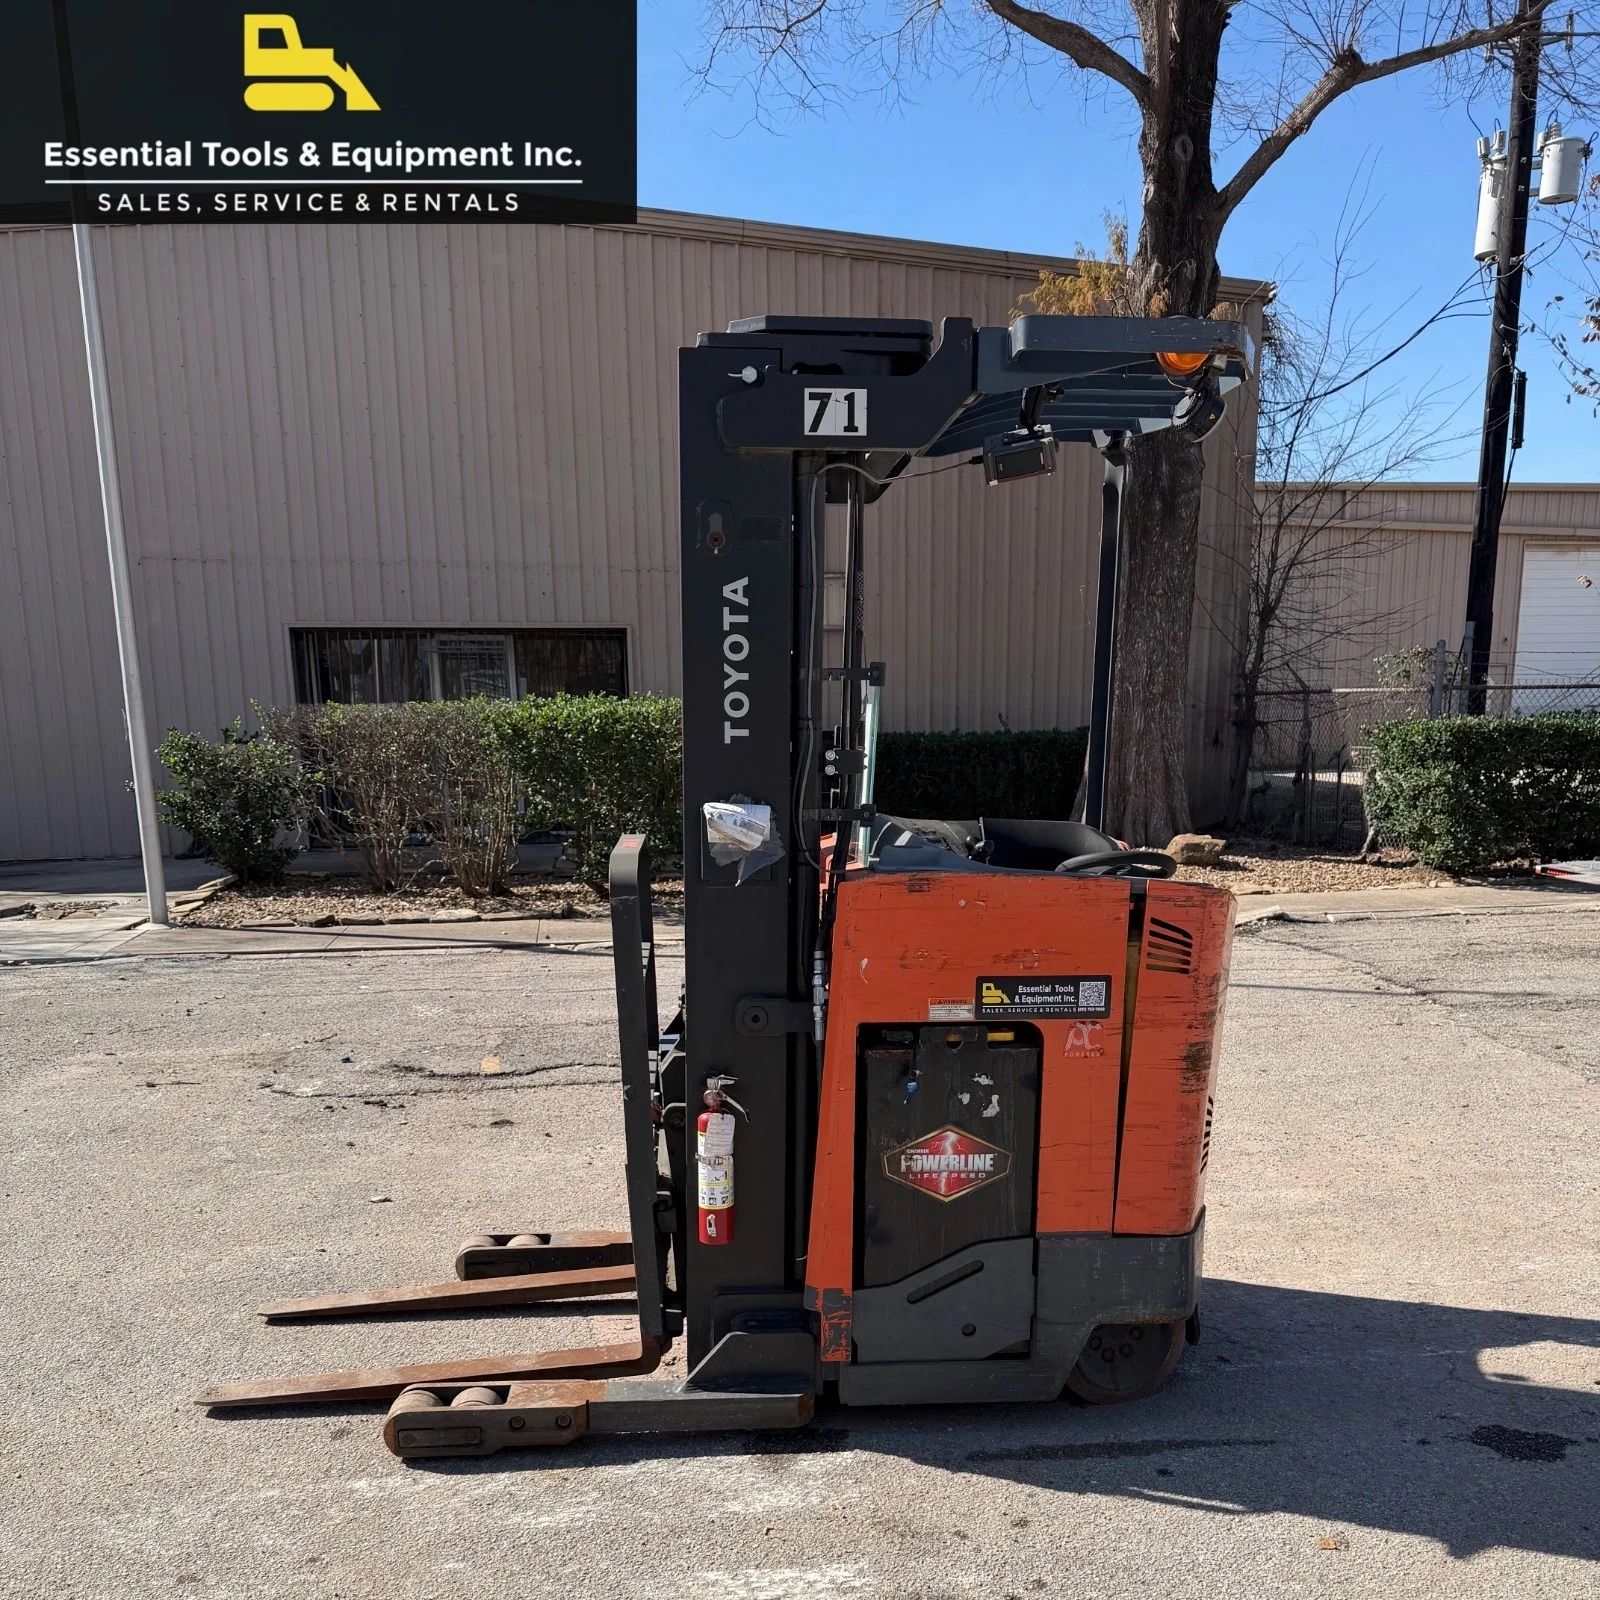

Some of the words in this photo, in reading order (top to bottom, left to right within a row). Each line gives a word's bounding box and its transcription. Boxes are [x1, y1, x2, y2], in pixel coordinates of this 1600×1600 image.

[808, 391, 859, 433] 71
[723, 576, 750, 744] TOYOTA
[1018, 984, 1051, 993] Essential
[1055, 984, 1074, 993] Tools
[1014, 995, 1020, 1003] &
[1022, 994, 1062, 1005] Equipment
[1063, 994, 1077, 1003] Inc.
[901, 1154, 994, 1172] POWERLINE
